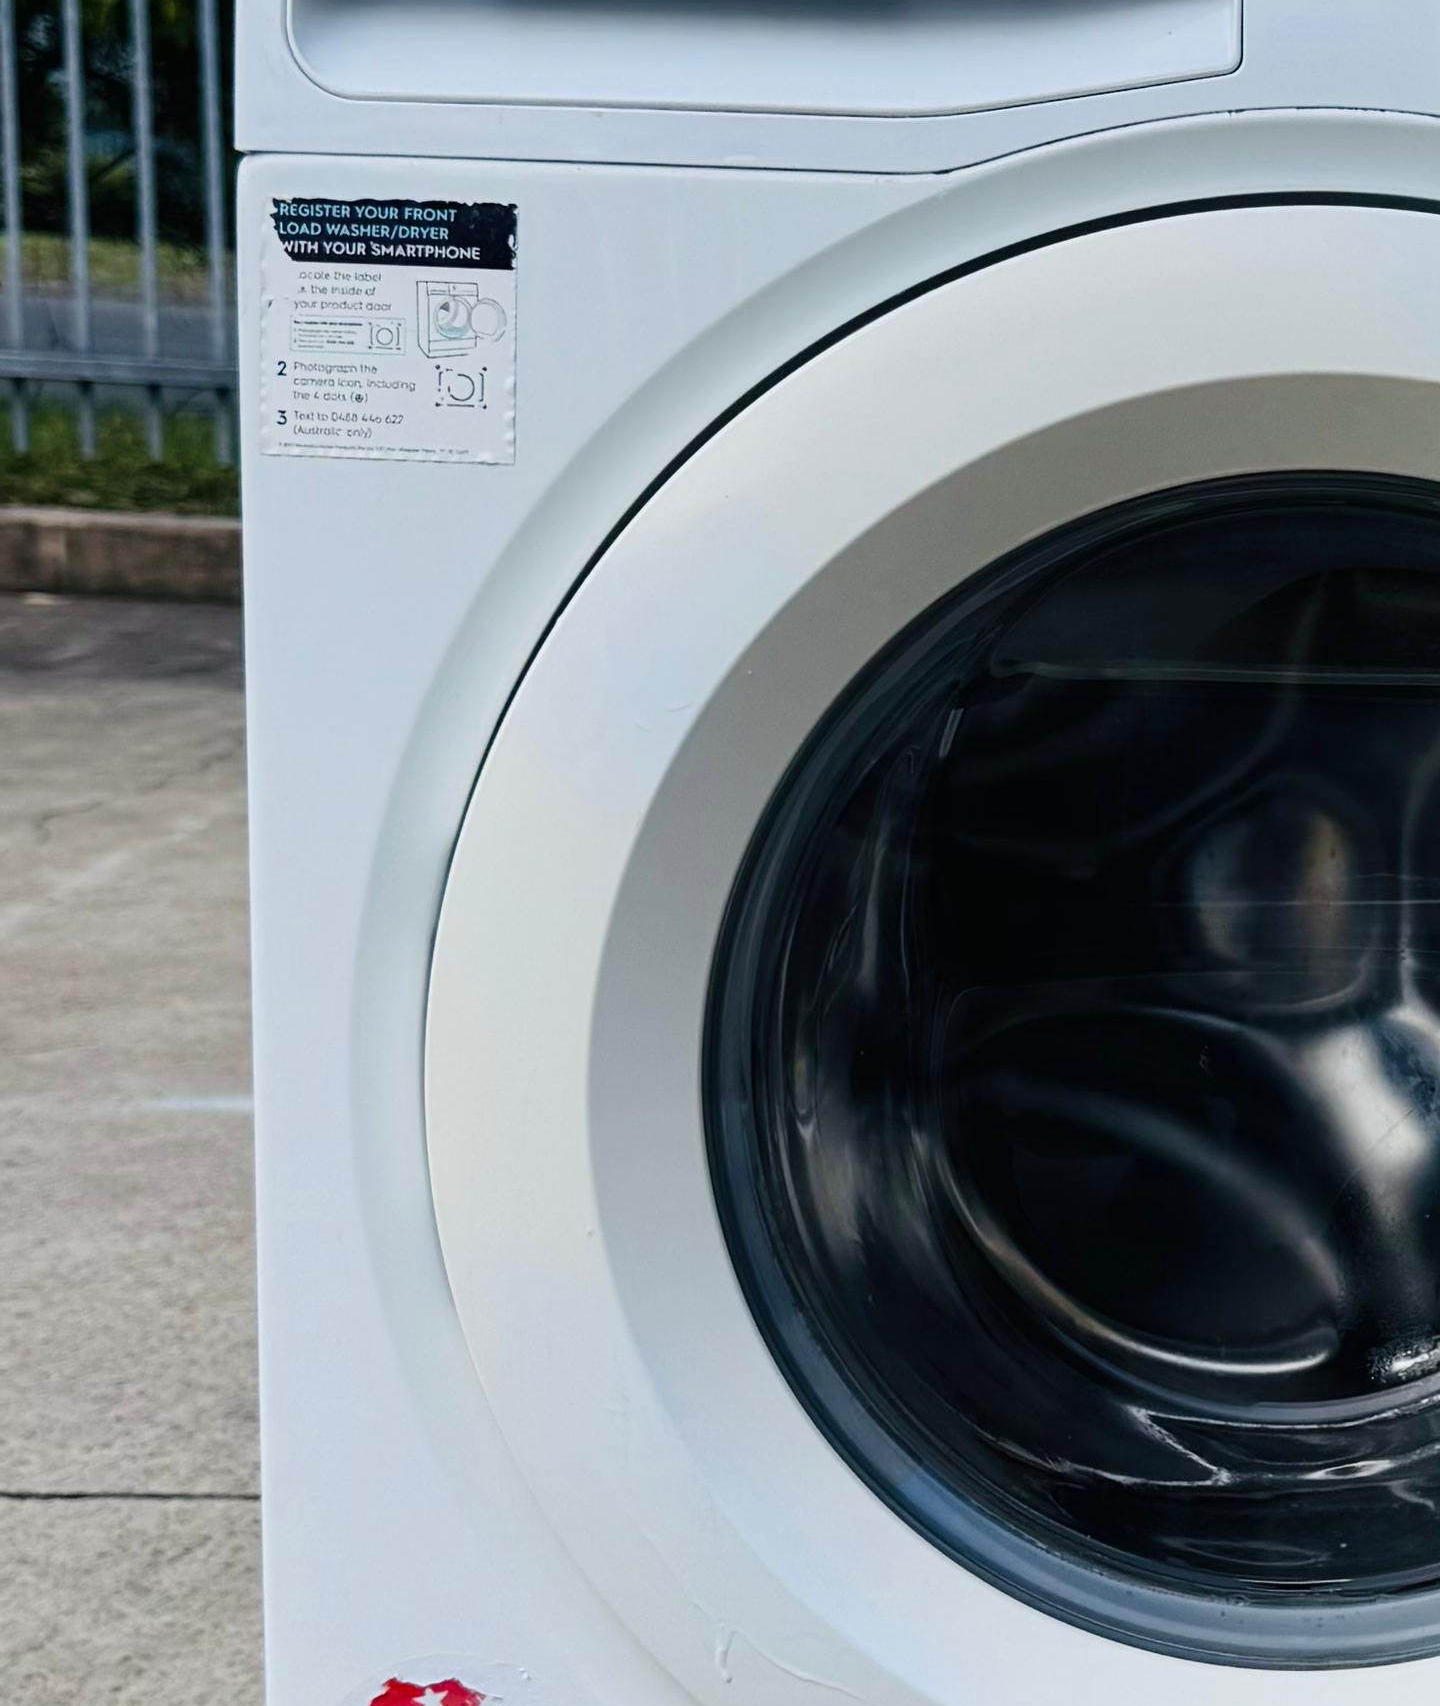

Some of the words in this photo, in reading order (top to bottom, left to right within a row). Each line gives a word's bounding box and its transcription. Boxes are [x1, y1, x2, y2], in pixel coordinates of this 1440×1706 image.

[279, 203, 350, 219] REGISTER
[356, 205, 399, 220] YOUR
[404, 207, 457, 222] FRONT
[279, 222, 321, 235] LOAD
[326, 223, 449, 240] WASHER/DRYER
[323, 241, 366, 256] YOUR
[370, 244, 481, 261] SMARTPHONE
[277, 360, 287, 376] 2
[277, 410, 287, 425] 3
